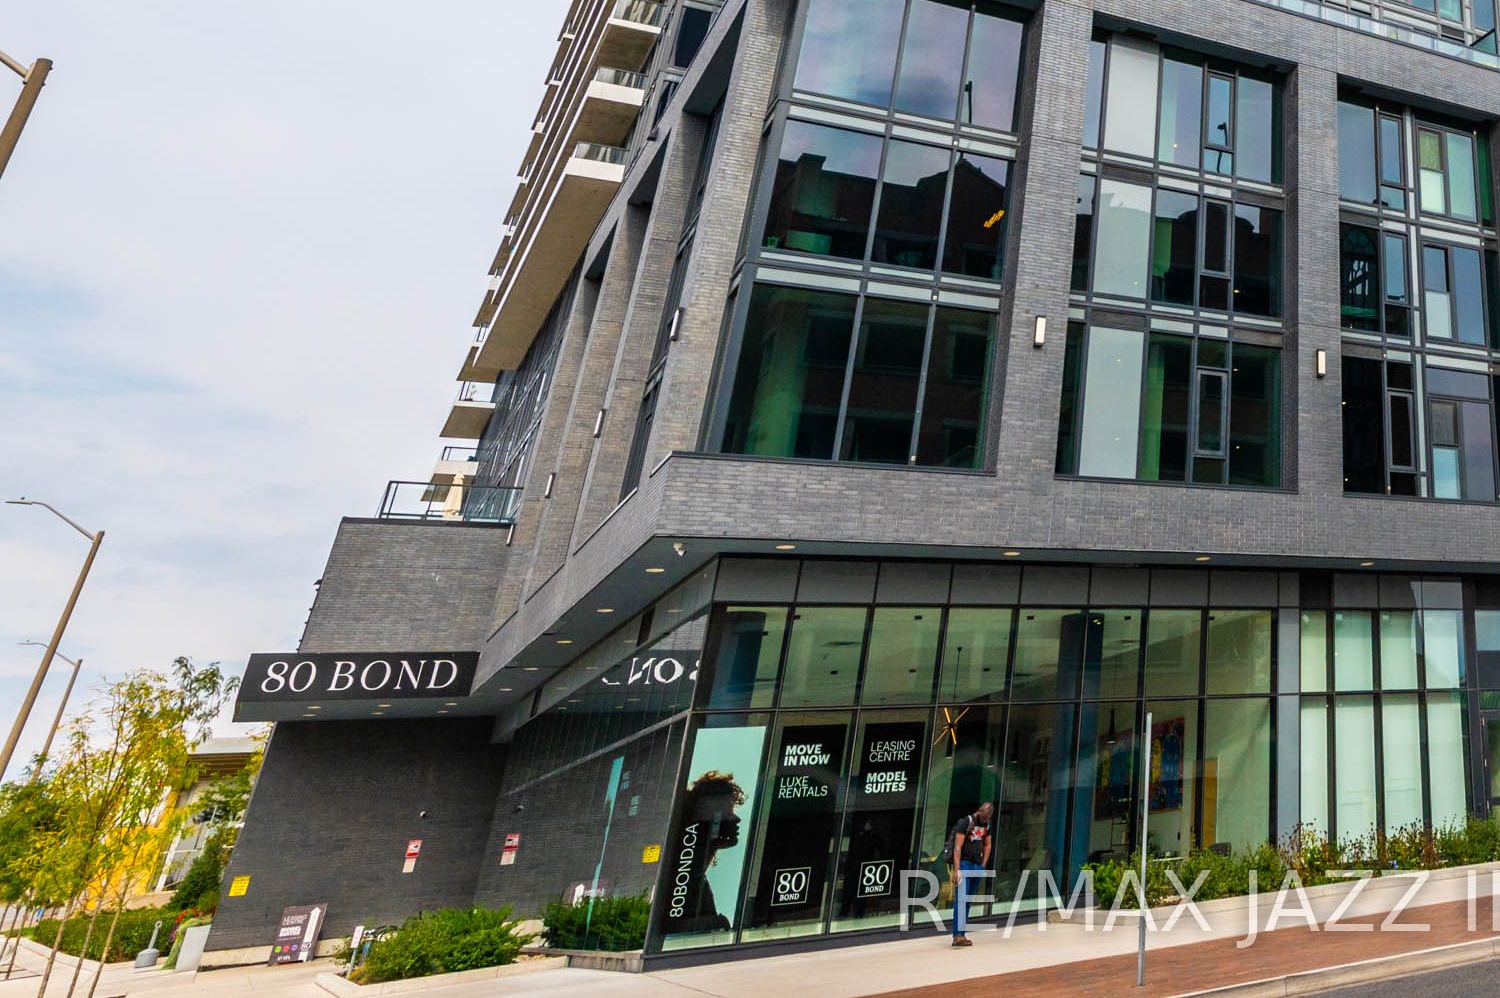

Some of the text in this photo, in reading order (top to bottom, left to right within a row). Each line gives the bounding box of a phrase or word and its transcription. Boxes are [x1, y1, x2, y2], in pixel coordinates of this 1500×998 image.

[261, 660, 458, 692] 80 BOND
[785, 744, 822, 755] MOVE
[870, 740, 915, 752] LEASING
[784, 754, 830, 766] IN NOW
[869, 751, 911, 762] CENTRE
[780, 776, 809, 788] LUXE
[866, 771, 907, 782] MODEL
[778, 785, 828, 799] RENTALS
[864, 782, 906, 793] SUITES
[670, 823, 699, 917] 80BOND.CA
[863, 864, 889, 886] 80
[777, 871, 806, 894] 80
[865, 885, 884, 893] BOND
[779, 893, 800, 902] BOND
